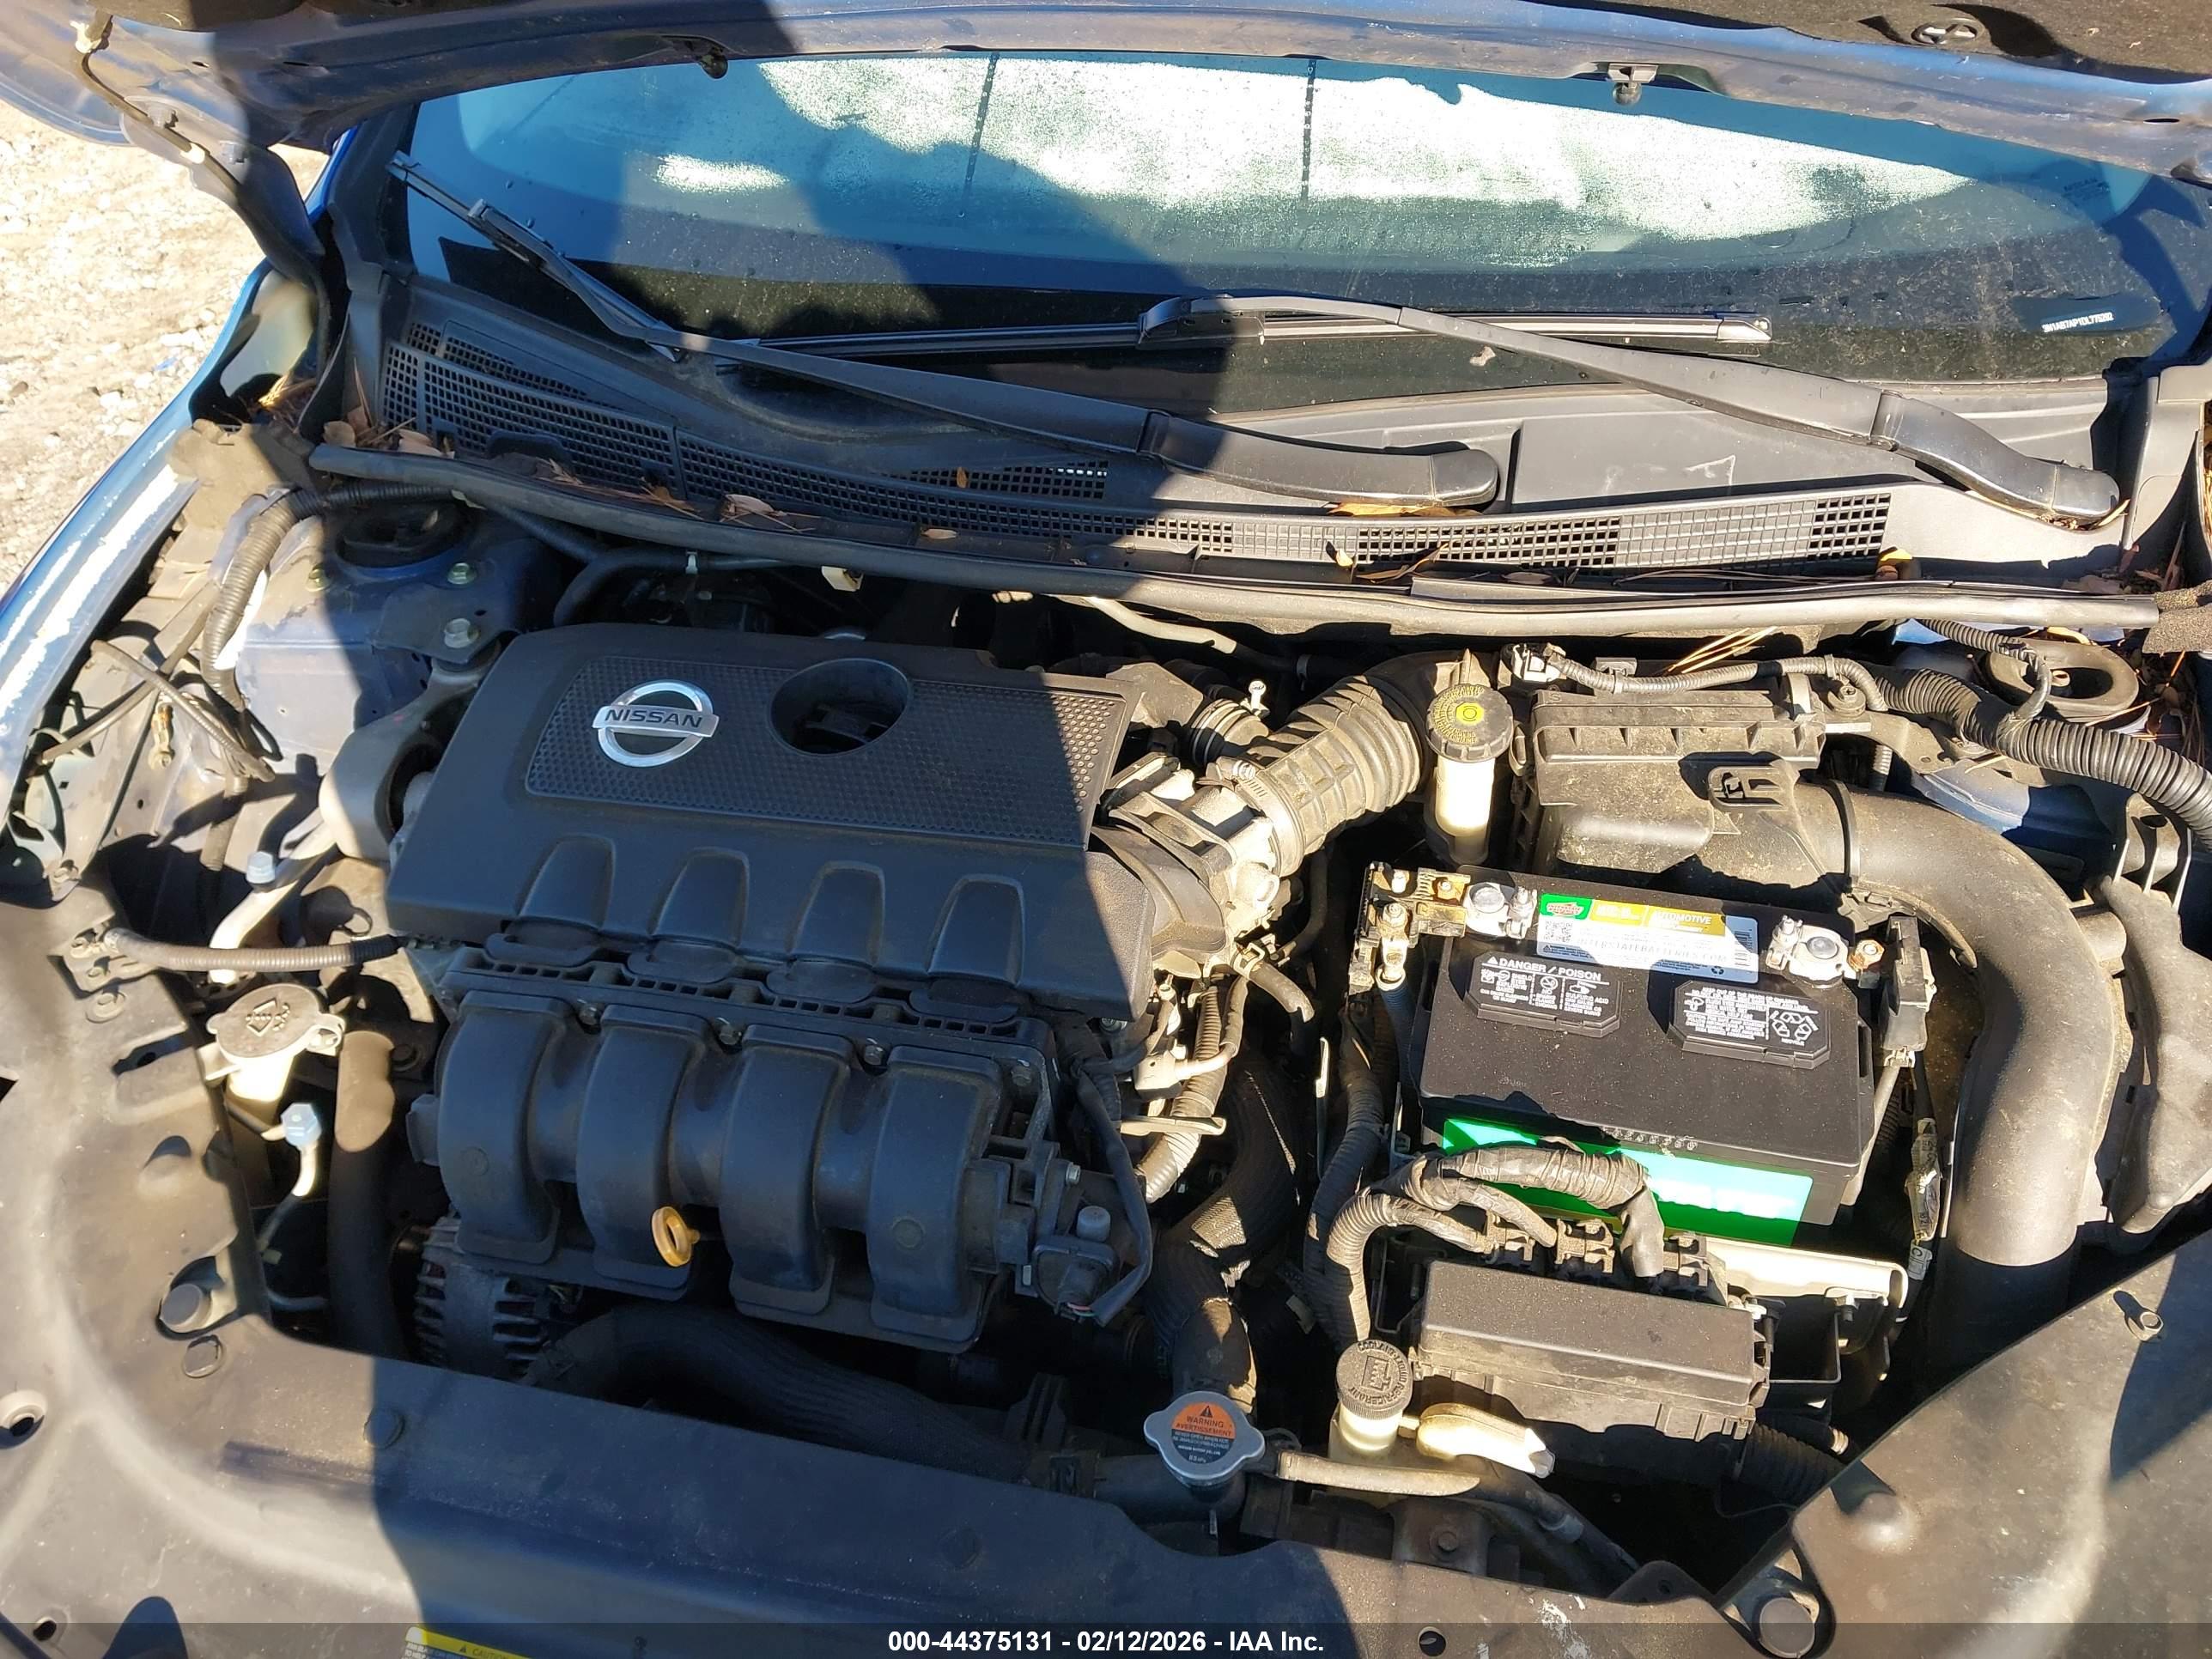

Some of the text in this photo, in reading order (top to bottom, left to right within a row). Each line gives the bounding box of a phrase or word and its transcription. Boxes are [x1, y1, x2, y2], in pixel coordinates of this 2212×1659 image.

[605, 708, 702, 728] NISSAN
[1499, 958, 1547, 973] DANGER
[1559, 968, 1601, 981] POISON
[1187, 1415, 1224, 1427] WARNING
[1176, 1423, 1231, 1437] AVERTISSEMENT
